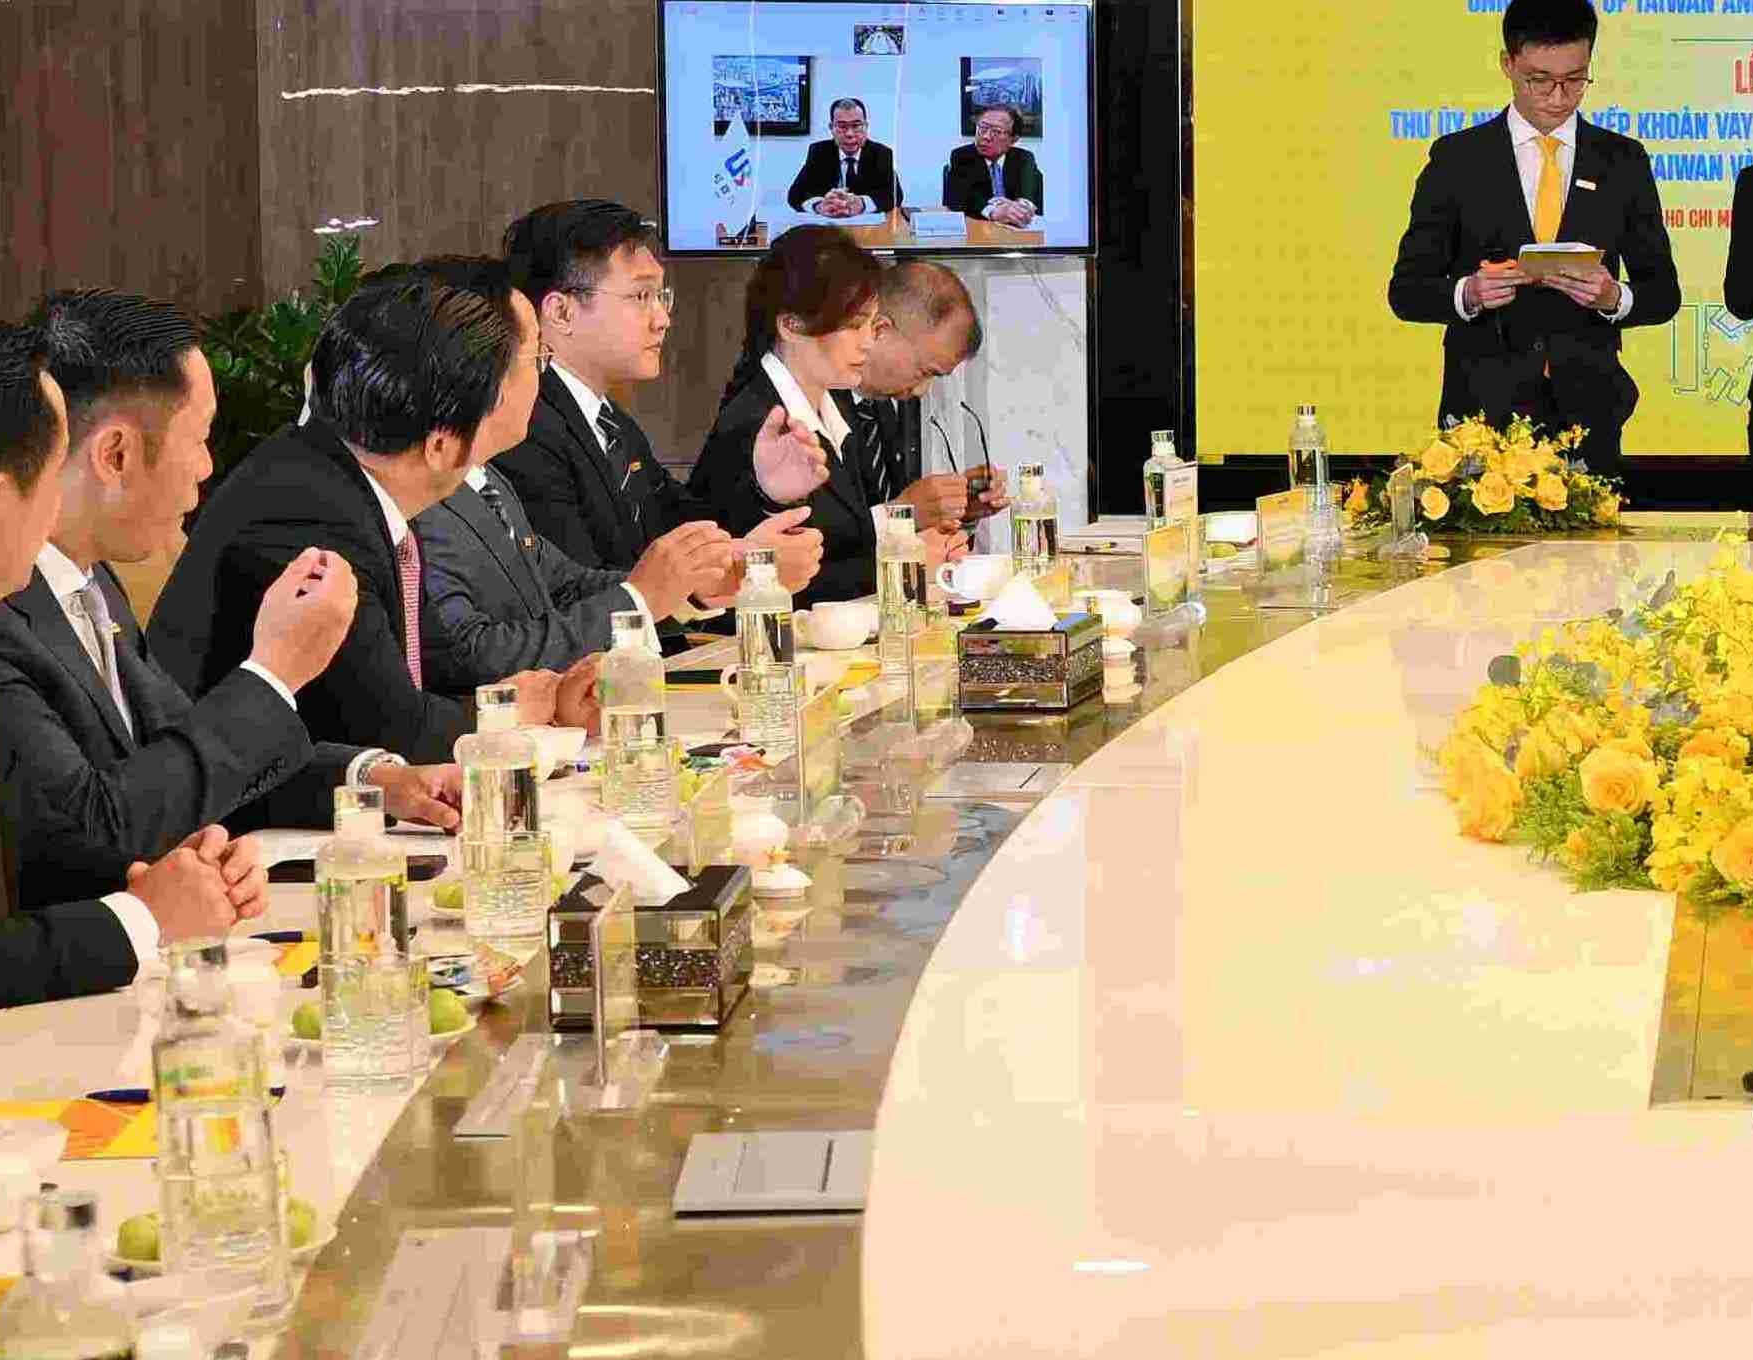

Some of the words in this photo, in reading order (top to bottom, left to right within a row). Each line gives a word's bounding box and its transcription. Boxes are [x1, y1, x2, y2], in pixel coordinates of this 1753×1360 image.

[1390, 110, 1432, 139] THƯ
[1638, 105, 1709, 141] KHOẢN
[1715, 111, 1753, 140] VAY
